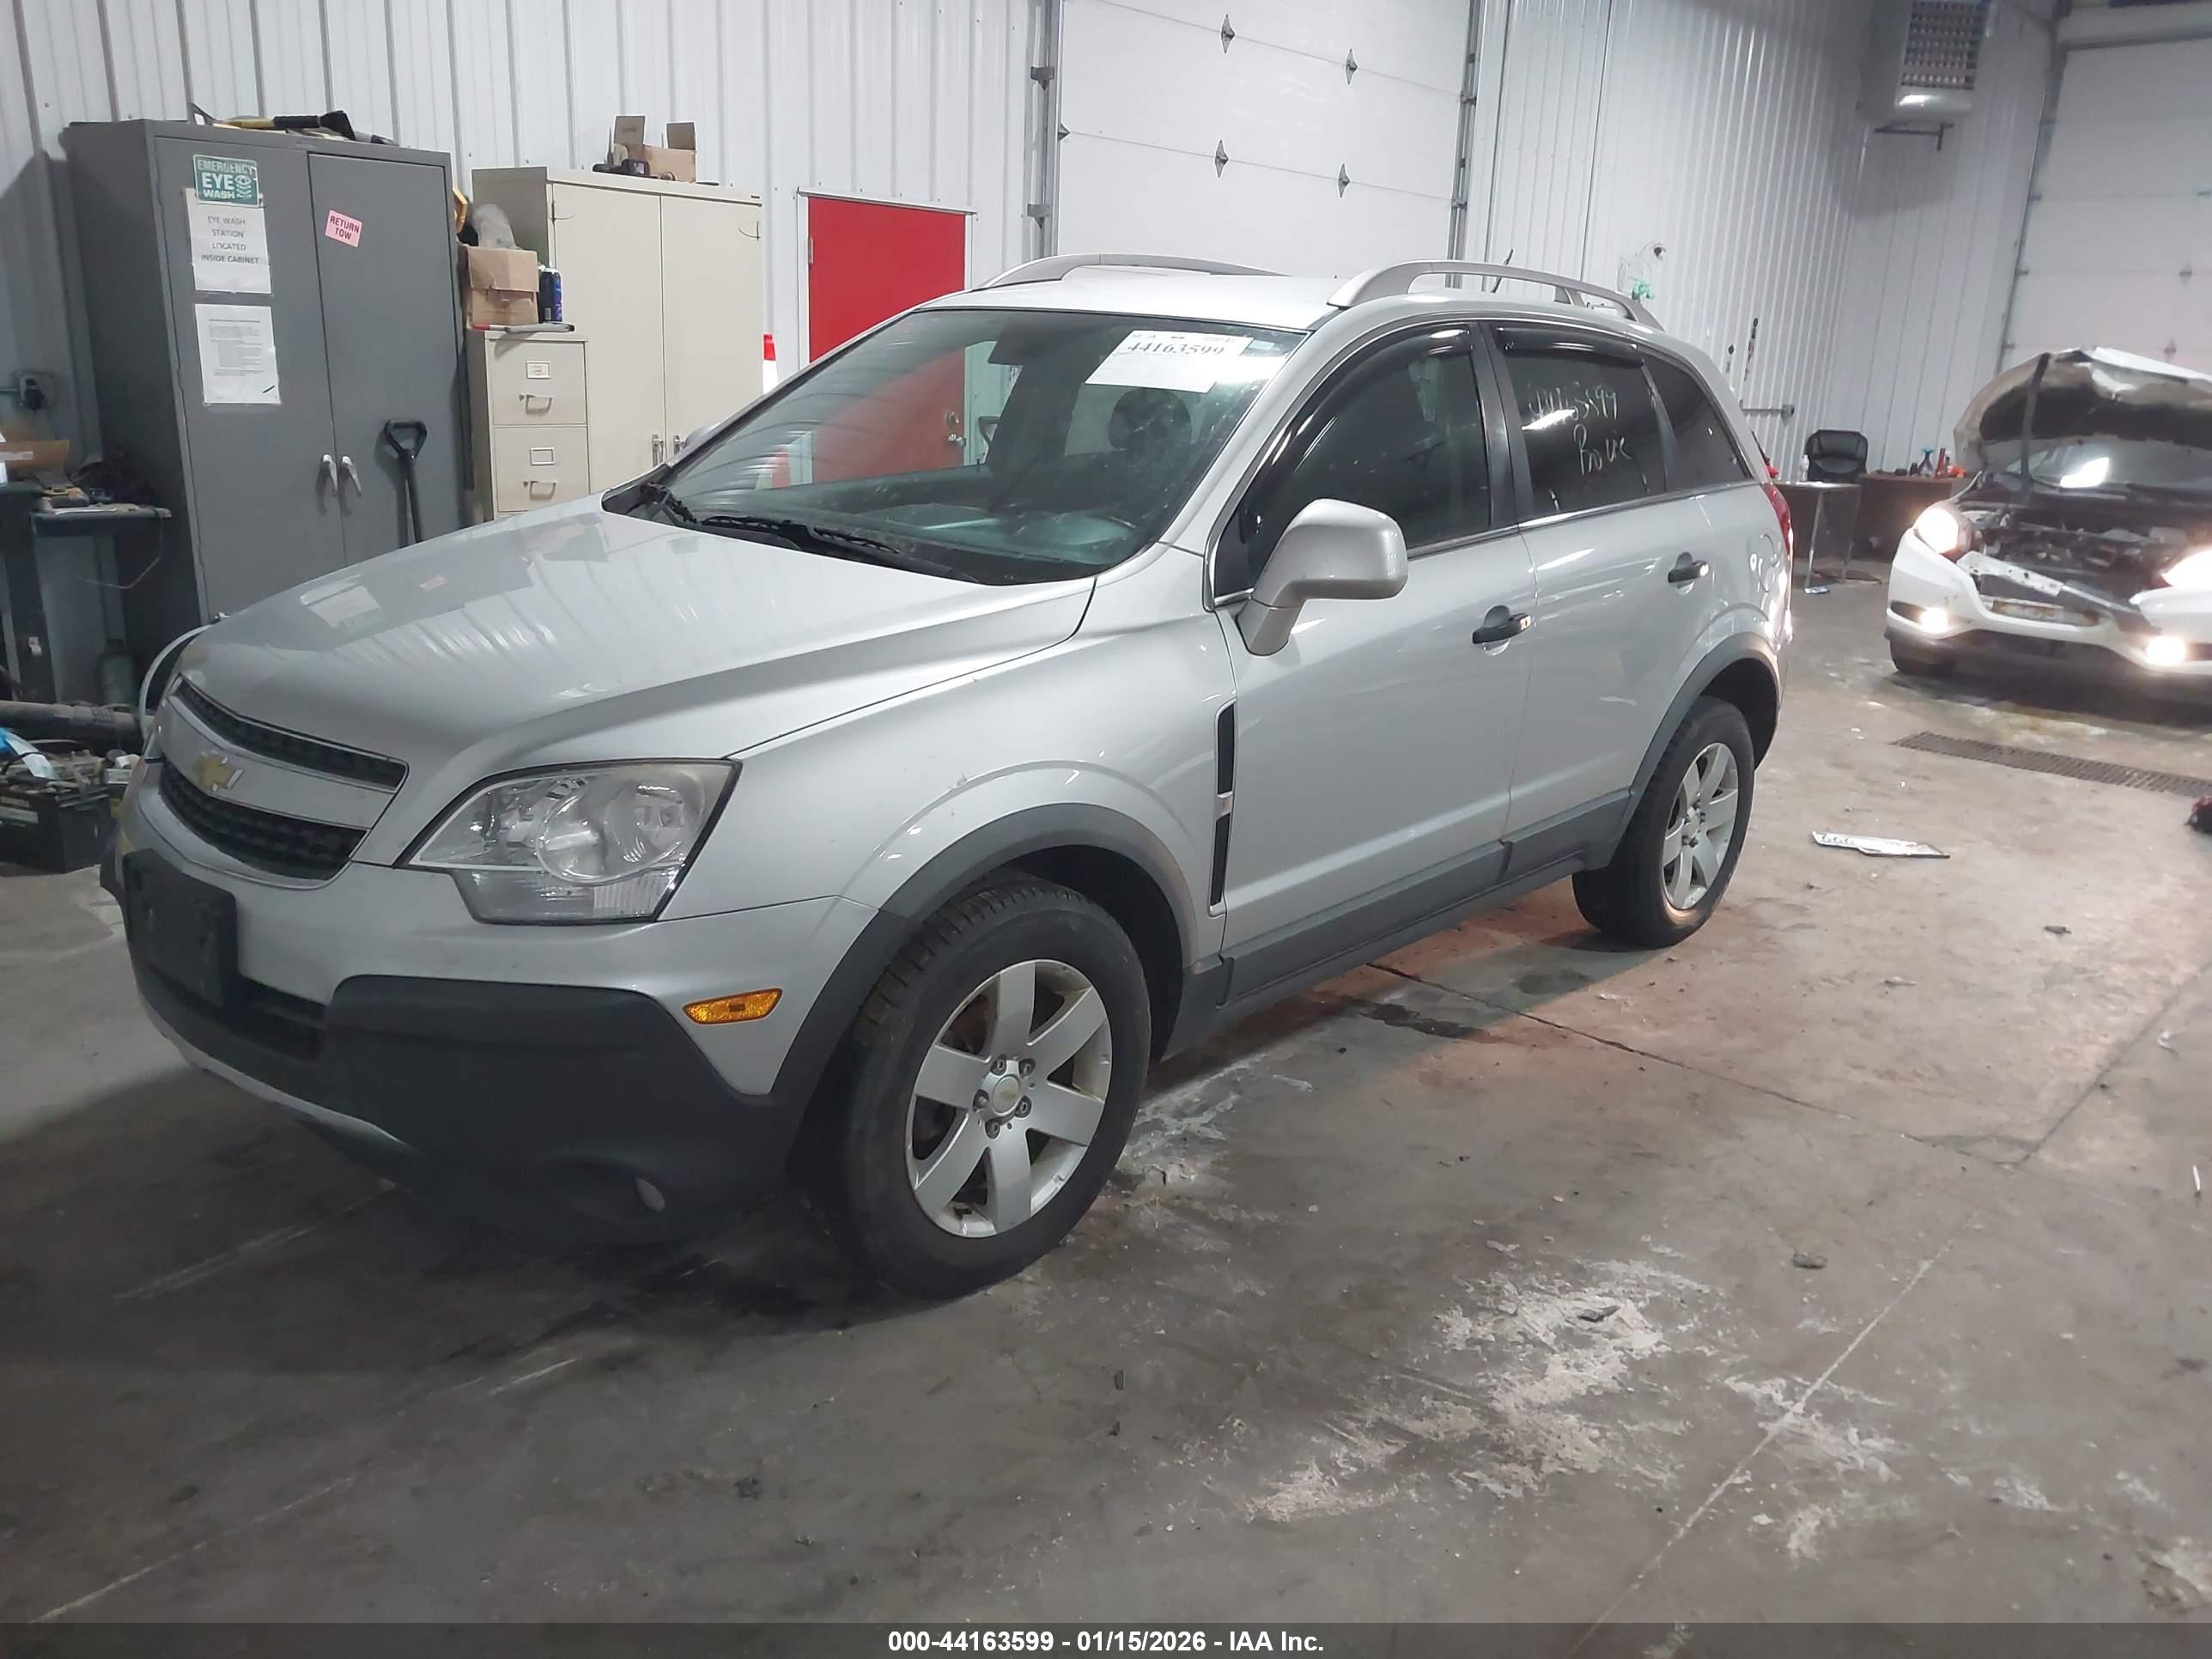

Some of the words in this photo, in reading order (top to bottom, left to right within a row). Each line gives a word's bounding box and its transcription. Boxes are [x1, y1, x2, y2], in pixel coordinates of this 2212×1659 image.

[198, 159, 252, 174] EMERGENCY
[202, 172, 234, 190] EYE
[203, 189, 235, 199] WASH
[207, 216, 220, 224] EYE
[222, 217, 246, 226] WASH
[330, 216, 359, 234] RETURN
[211, 228, 244, 238] STATION
[335, 227, 351, 240] TOW
[212, 242, 246, 251] LOCATED
[201, 254, 225, 263] INSIDE
[227, 255, 259, 264] CABINET
[1127, 342, 1225, 356] 44163599
